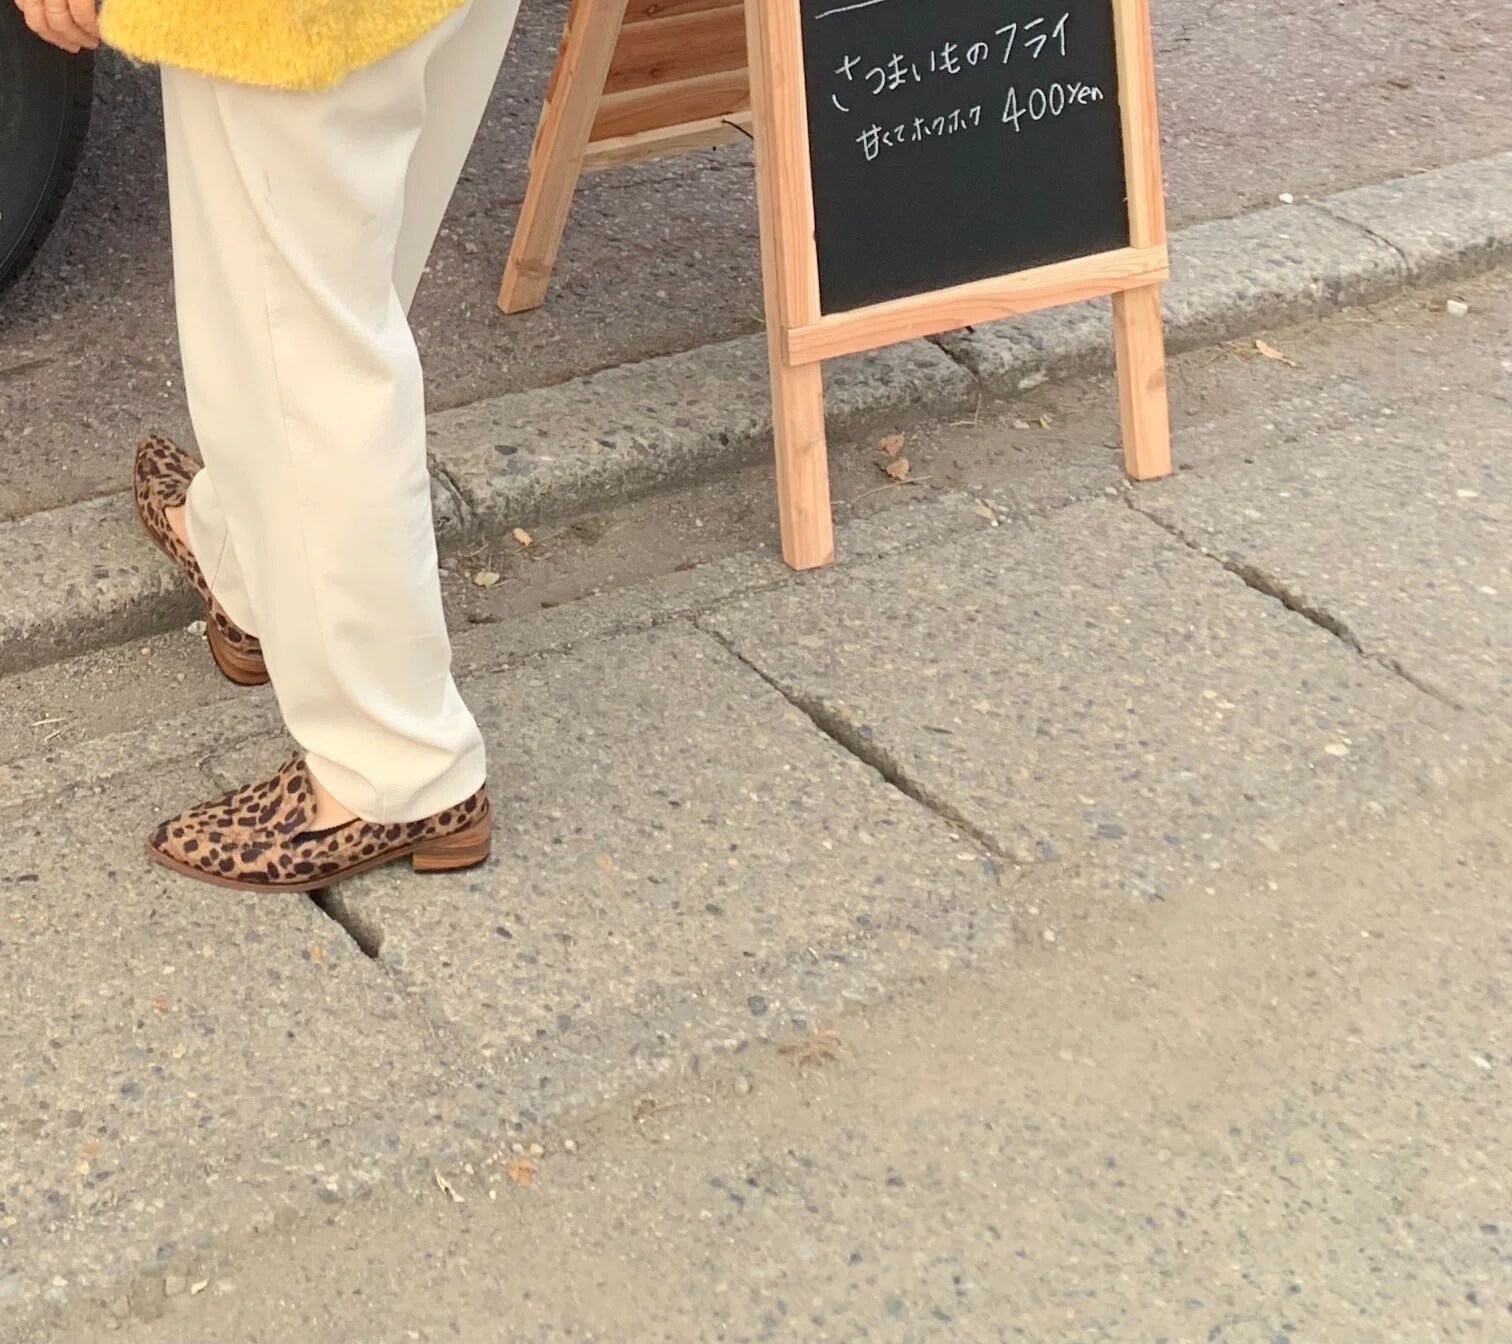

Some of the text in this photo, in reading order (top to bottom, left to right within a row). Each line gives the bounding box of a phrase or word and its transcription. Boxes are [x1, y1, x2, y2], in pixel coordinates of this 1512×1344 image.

[832, 12, 1070, 113] さつまいものフライ
